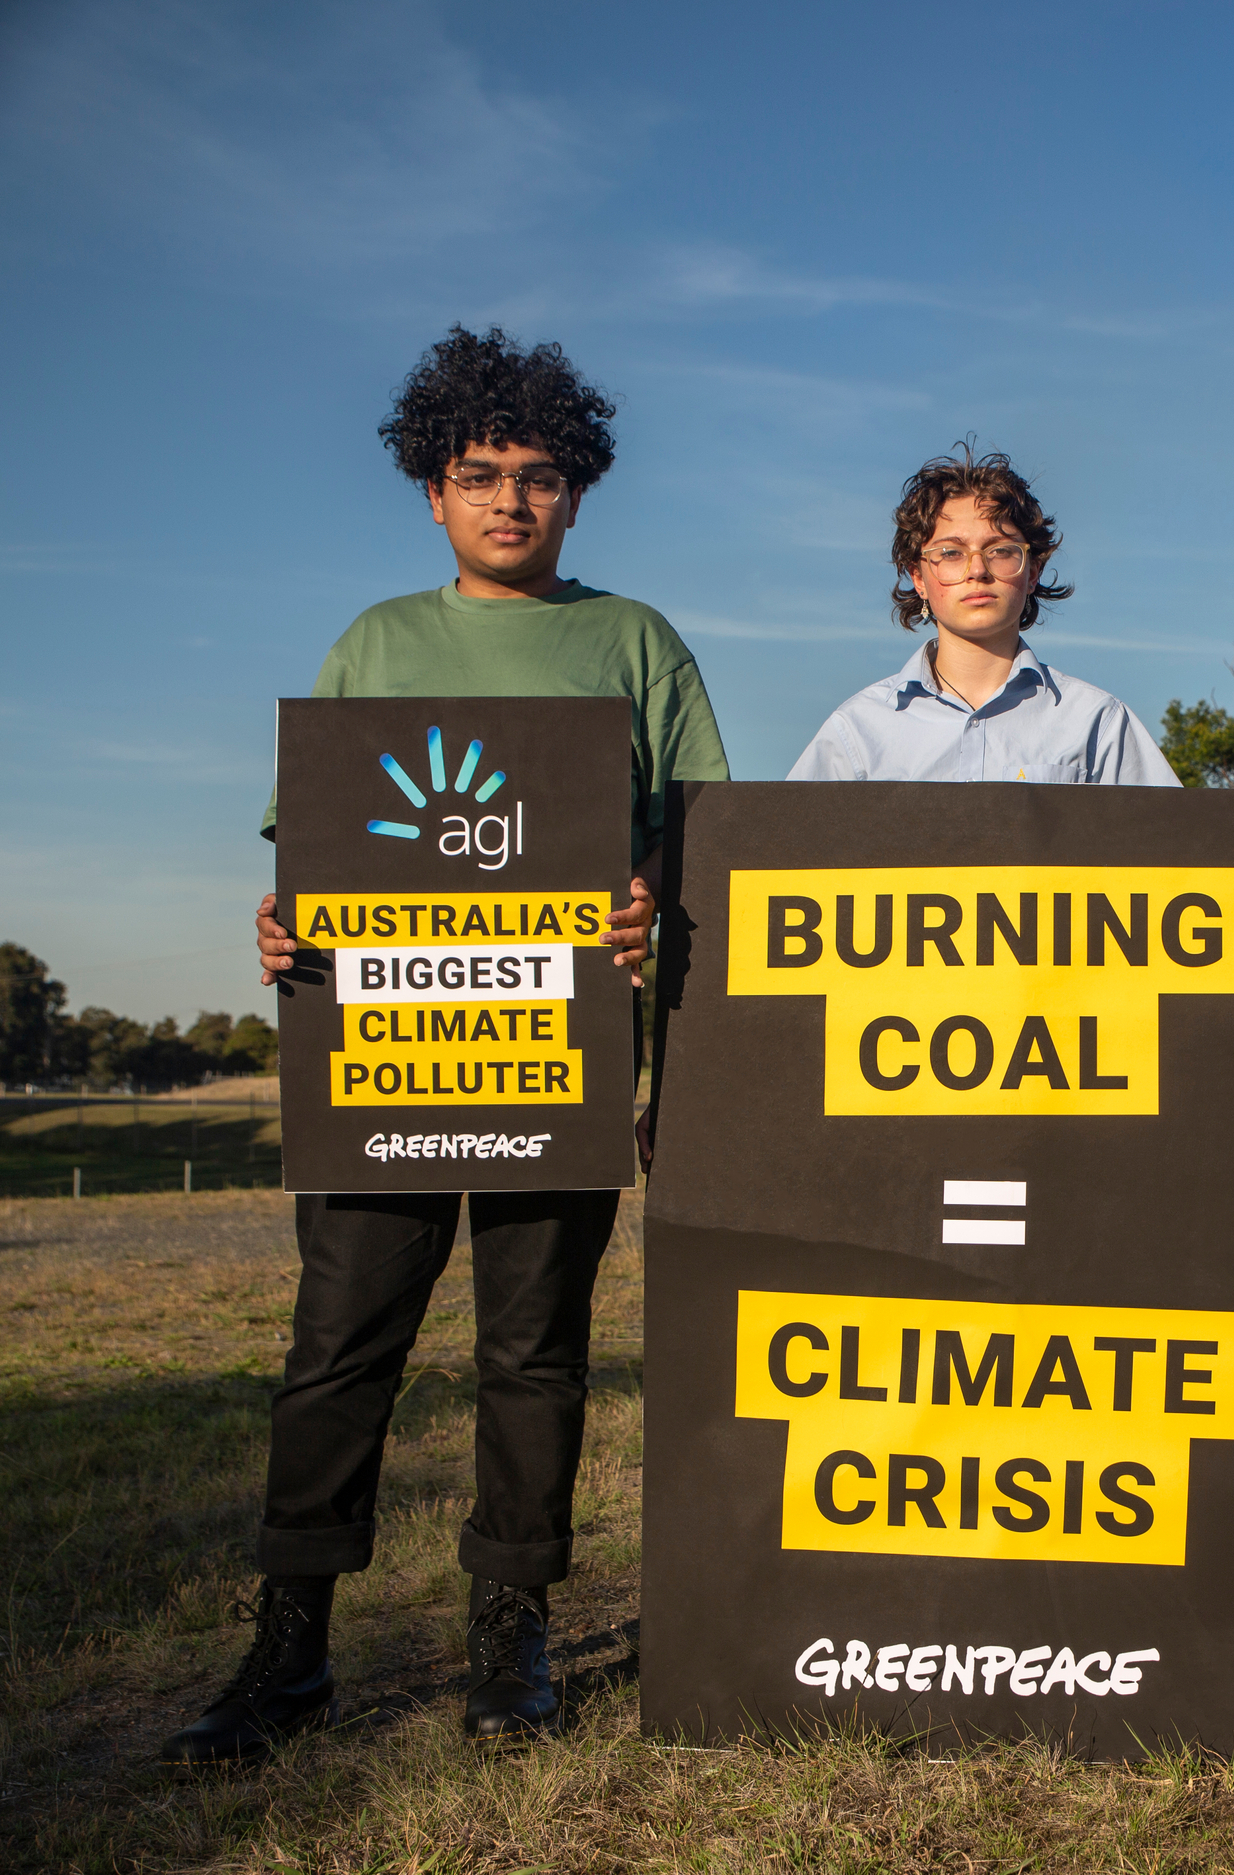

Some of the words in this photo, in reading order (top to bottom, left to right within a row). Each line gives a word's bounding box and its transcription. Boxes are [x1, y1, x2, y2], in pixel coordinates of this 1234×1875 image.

[438, 798, 523, 871] agl
[307, 902, 600, 938] AUSTRALIA’S
[766, 893, 1223, 968] BURNING
[360, 957, 552, 990] BIGGEST
[358, 1009, 554, 1043] CLIMATE
[858, 1015, 1129, 1092] COAL
[343, 1061, 571, 1095] POLLUTER
[364, 1133, 552, 1163] GREENPEACE
[767, 1322, 1219, 1415] CLIMATE
[814, 1450, 1156, 1538] CRISIS
[794, 1637, 1161, 1698] GREENPEACE
